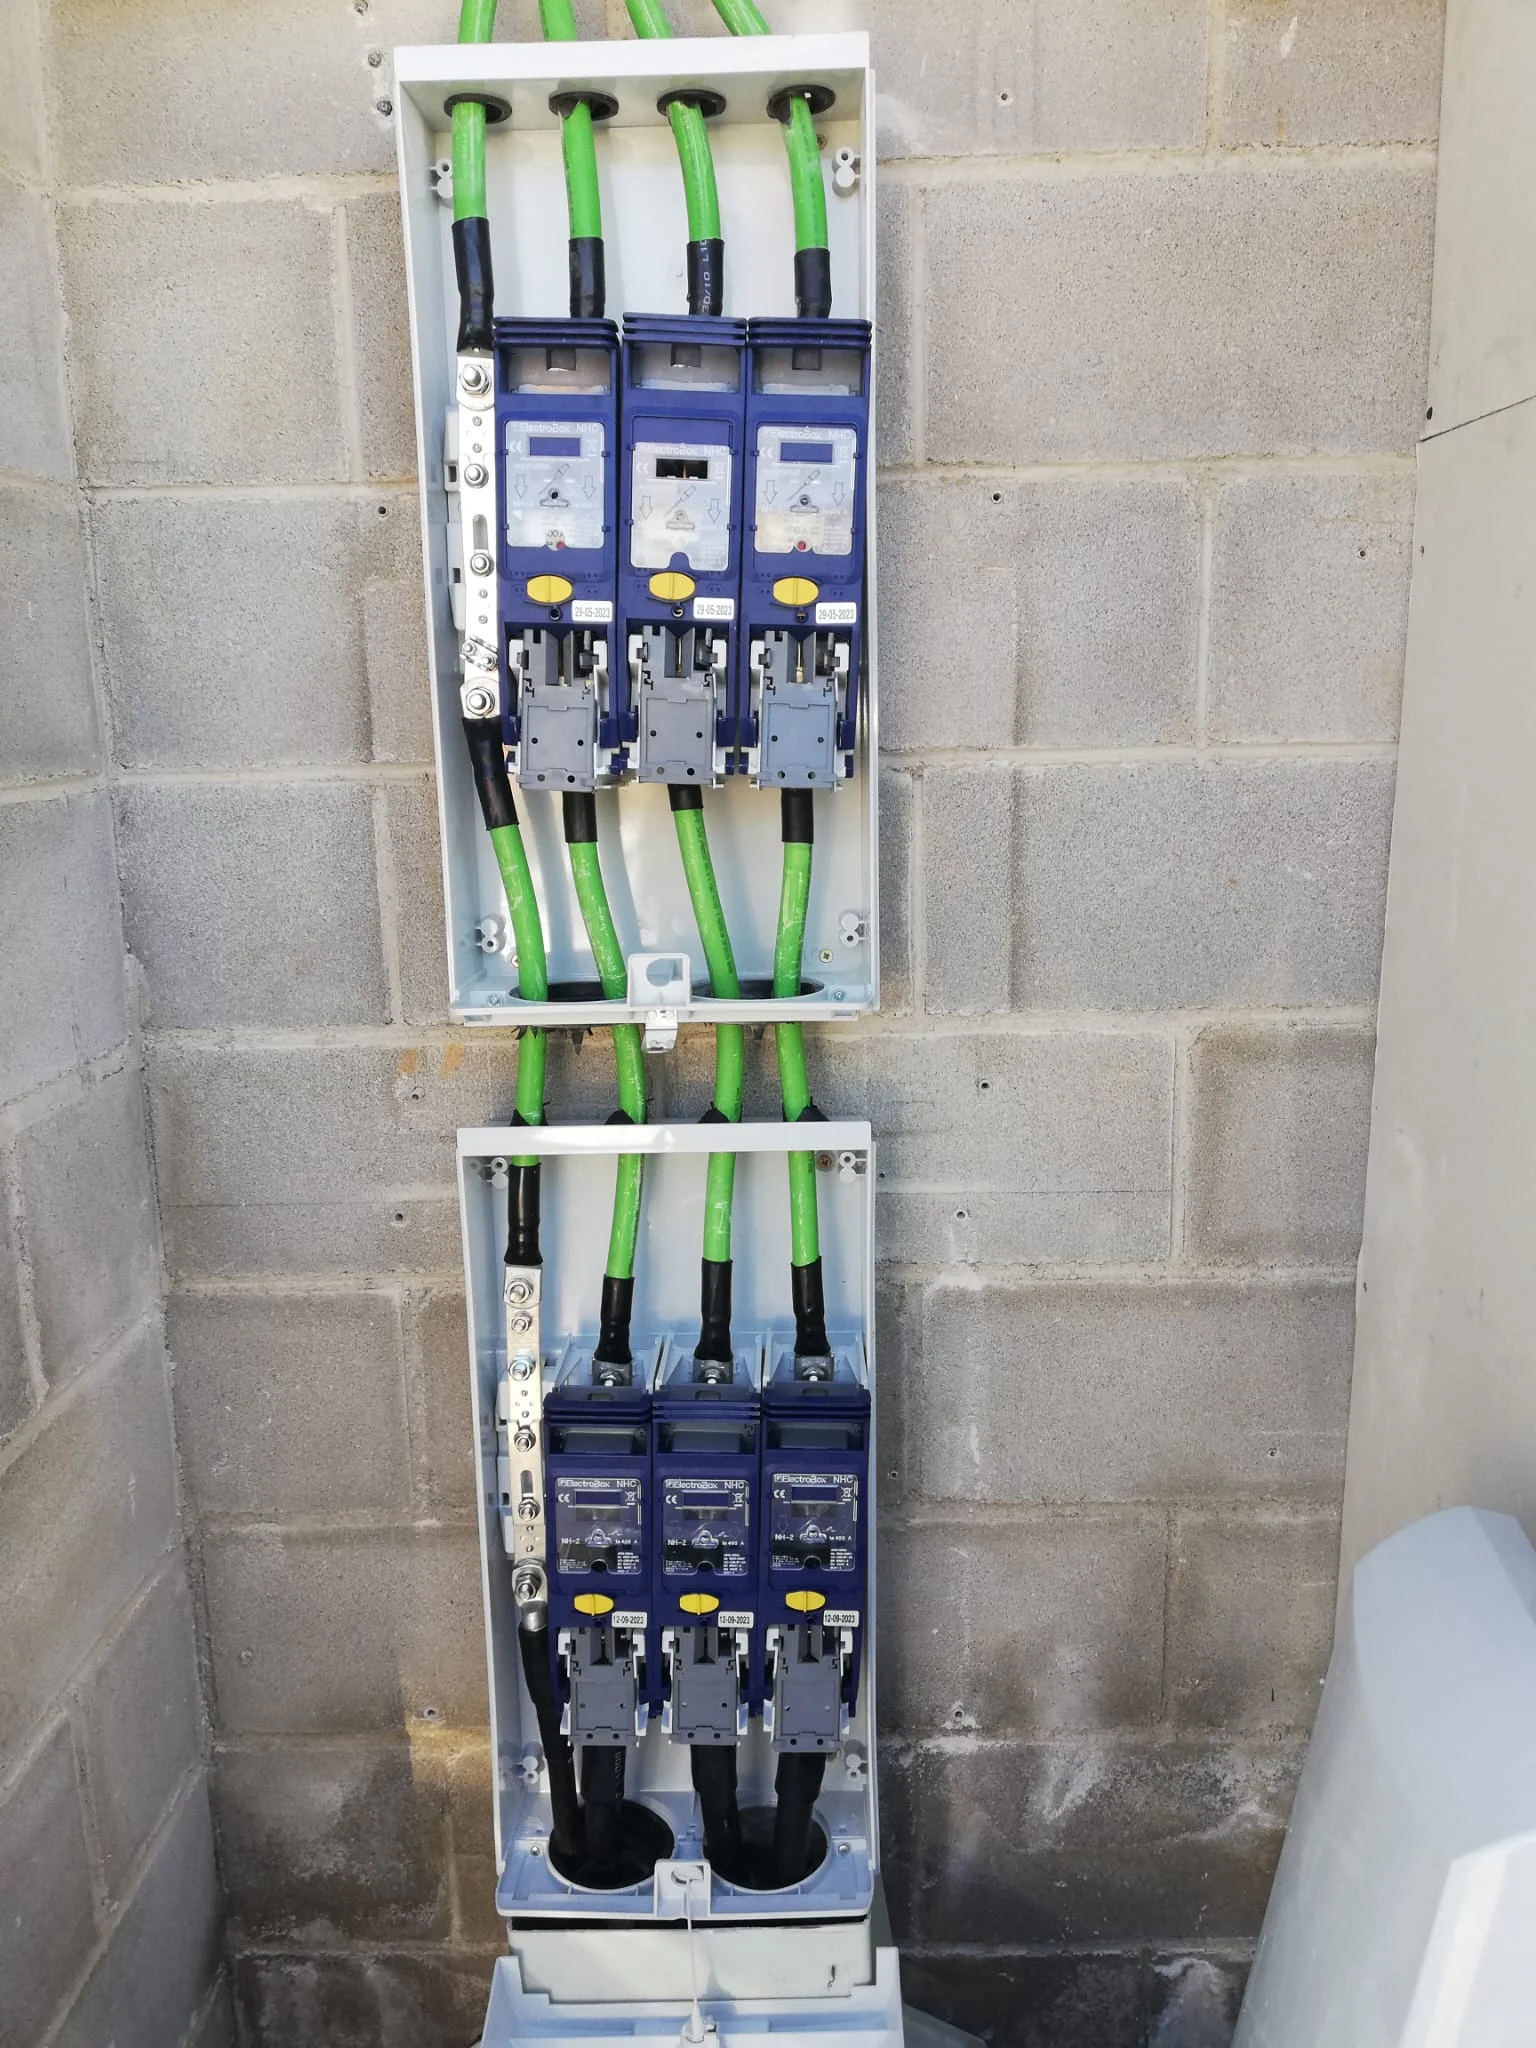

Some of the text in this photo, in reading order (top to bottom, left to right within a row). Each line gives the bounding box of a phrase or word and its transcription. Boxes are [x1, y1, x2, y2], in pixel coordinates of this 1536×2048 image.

[520, 423, 571, 433] ElectroBox
[574, 605, 611, 619] 29-05-2023
[696, 603, 733, 617] 29-05-2023
[818, 607, 855, 621] 29-05-2023
[566, 1480, 637, 1488] ElectroBox NHC
[782, 1475, 854, 1484] ElectroBox NHC
[674, 1481, 718, 1489] ElectroBox
[613, 1614, 645, 1625] 12-09-2023
[719, 1615, 750, 1625] 12-09-2023
[824, 1613, 856, 1624] 12-09-2023
